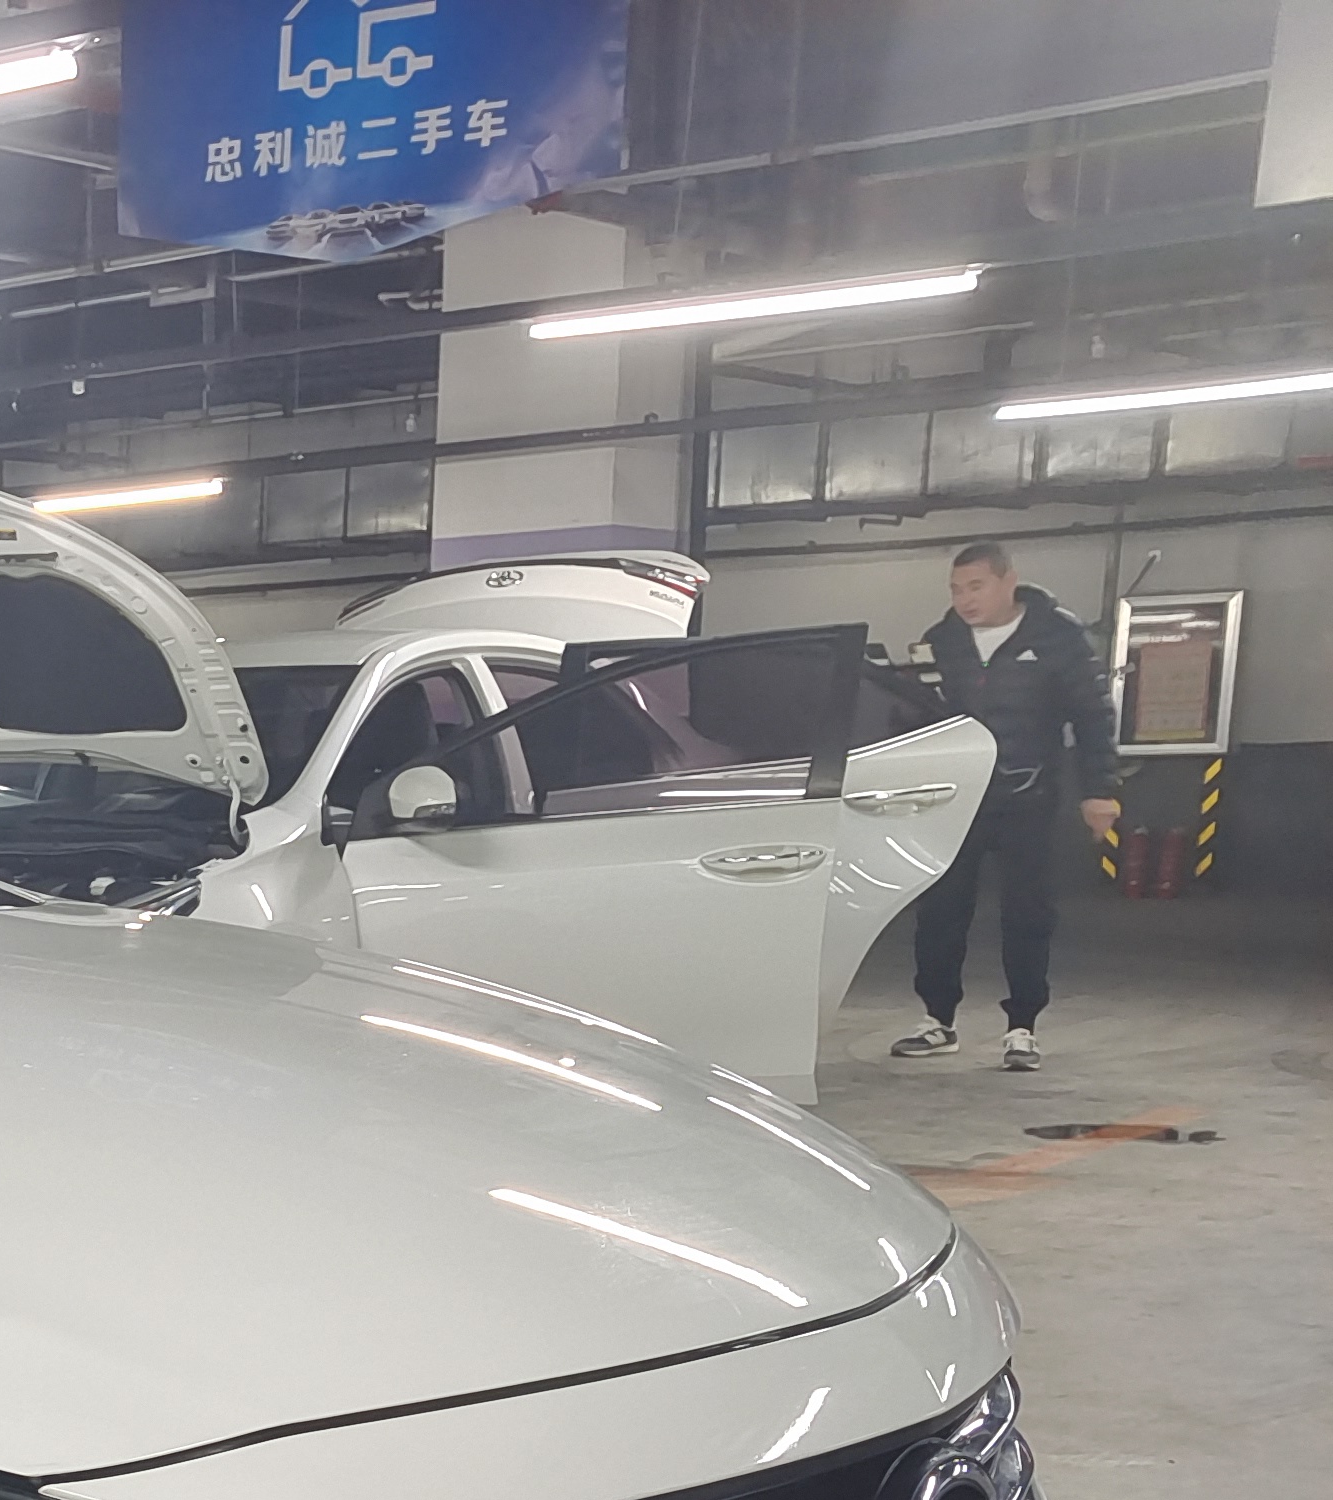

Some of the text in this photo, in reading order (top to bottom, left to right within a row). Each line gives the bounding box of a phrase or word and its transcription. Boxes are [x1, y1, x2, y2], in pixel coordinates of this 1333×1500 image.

[204, 99, 508, 183] 忠利诚二手车
